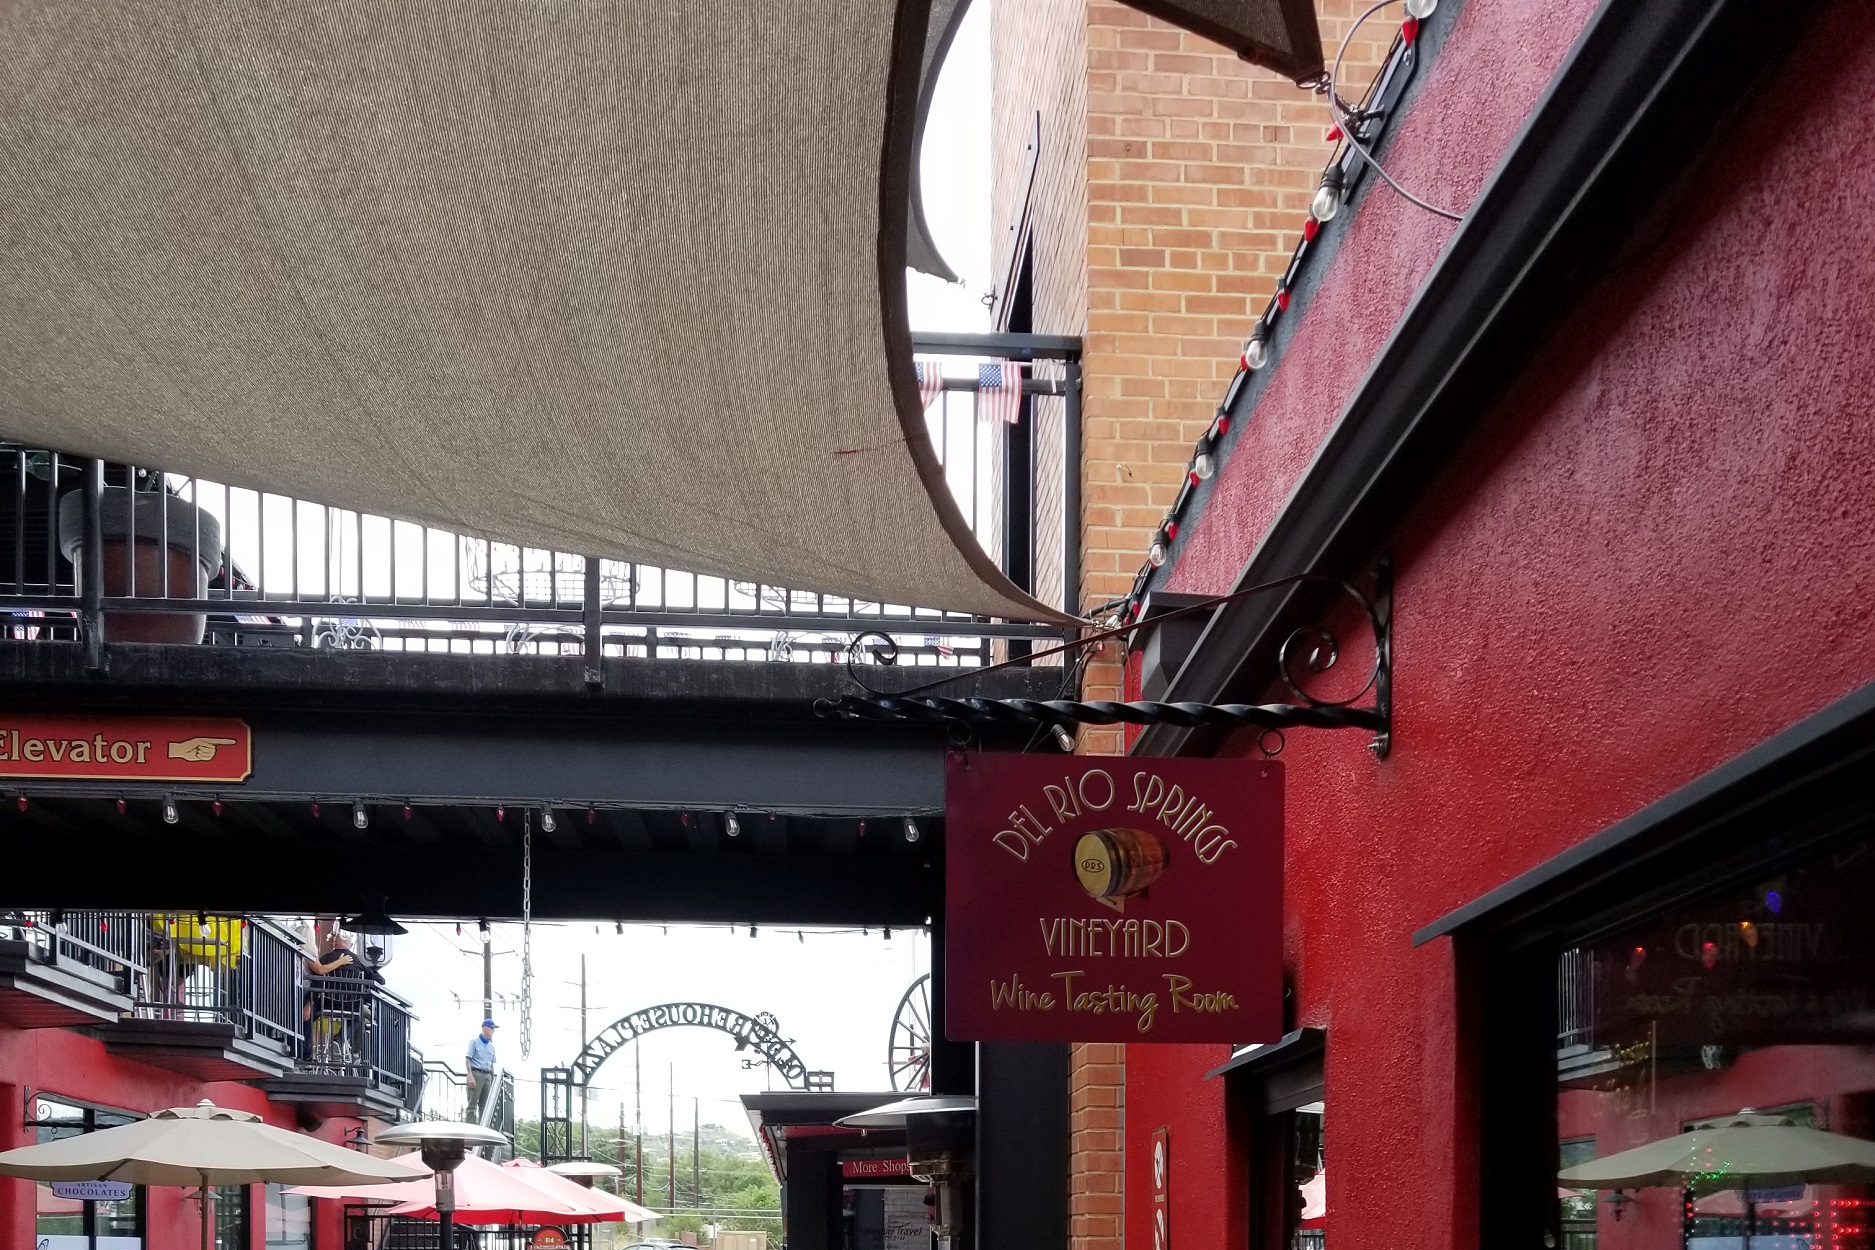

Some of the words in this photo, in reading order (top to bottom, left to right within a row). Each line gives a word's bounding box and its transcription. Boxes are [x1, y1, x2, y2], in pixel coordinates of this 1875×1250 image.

[0, 729, 151, 763] Elevator
[992, 804, 1053, 863] DEL
[1043, 769, 1116, 824] RIO
[1127, 771, 1238, 866] SPRINGS
[1084, 861, 1102, 871] DRS
[1039, 917, 1191, 959] VINEYARD
[990, 973, 1056, 1012] Wine
[1050, 970, 1159, 1033] Tasting
[1163, 973, 1240, 1014] Room
[853, 1161, 878, 1174] More
[883, 1160, 911, 1175] Shops
[57, 1187, 126, 1197] CHOCOLATES
